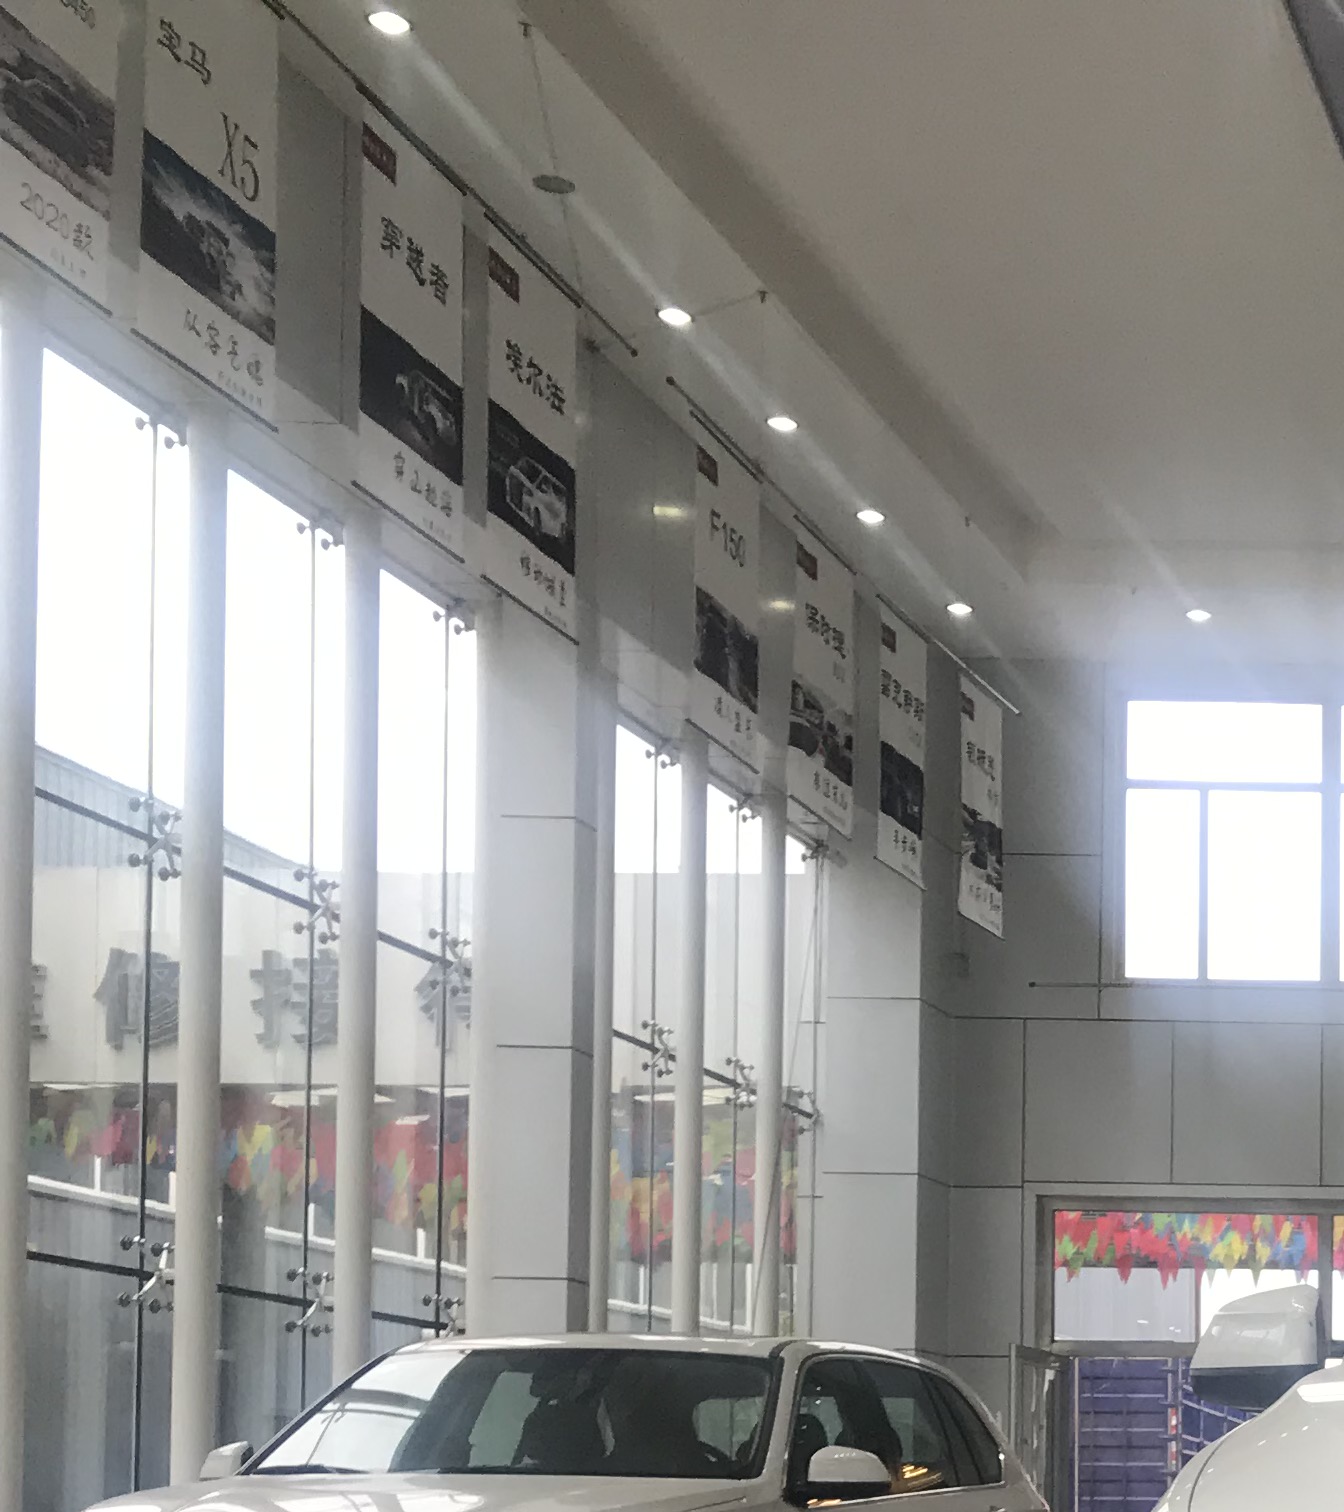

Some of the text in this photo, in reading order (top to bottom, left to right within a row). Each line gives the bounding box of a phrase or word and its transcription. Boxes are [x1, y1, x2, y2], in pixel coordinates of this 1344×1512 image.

[157, 17, 211, 85] 宝马
[218, 112, 260, 201] X5
[20, 182, 94, 260] 2020款
[709, 508, 747, 567] F150
